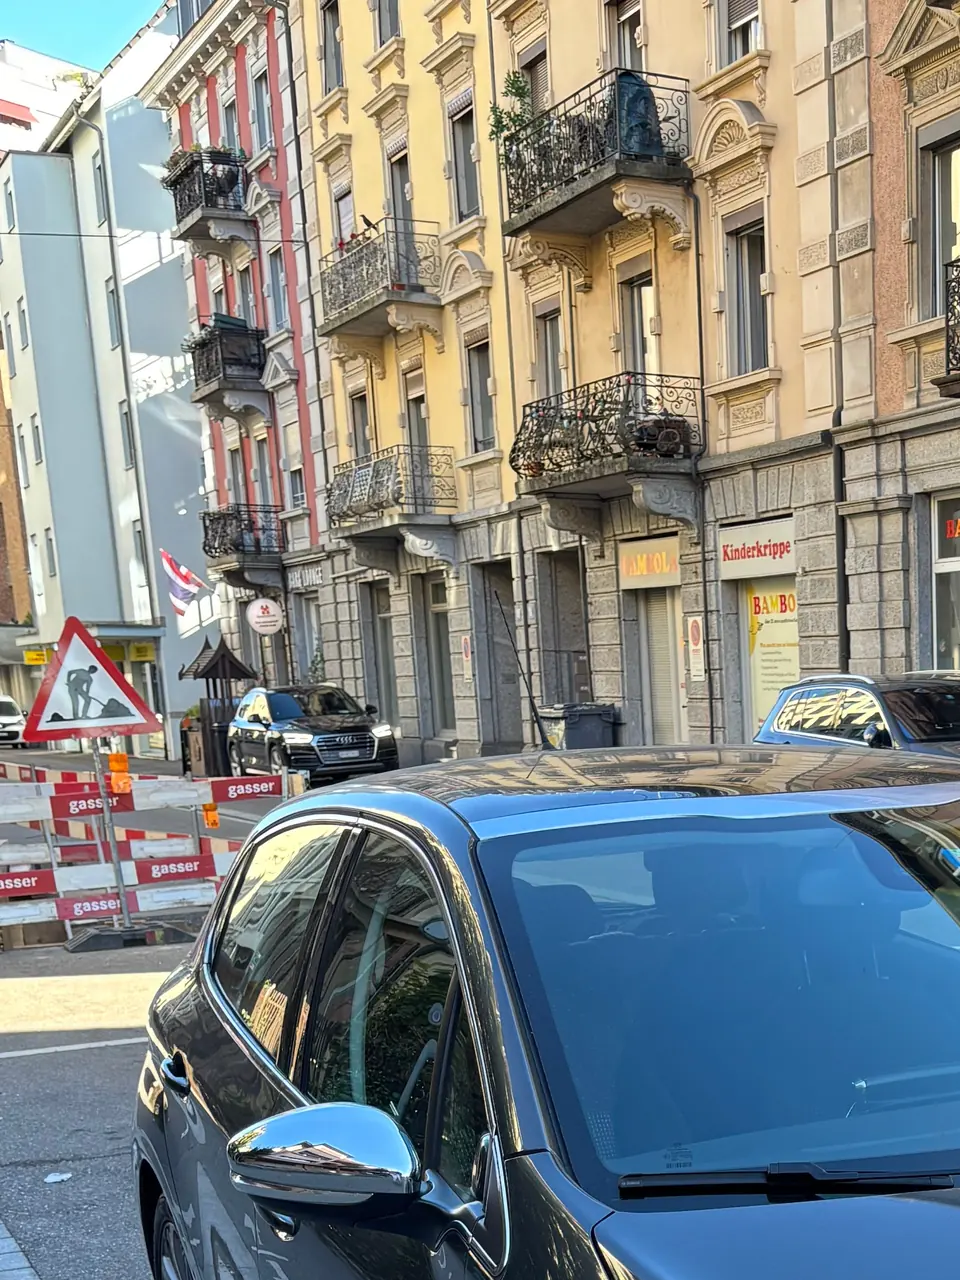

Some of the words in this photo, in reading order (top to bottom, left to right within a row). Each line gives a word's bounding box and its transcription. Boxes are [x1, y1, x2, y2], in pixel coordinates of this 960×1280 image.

[722, 539, 791, 561] Kinderkrippe
[752, 594, 796, 615] BAMBO
[228, 782, 275, 798] gasser
[151, 861, 199, 878] gasser
